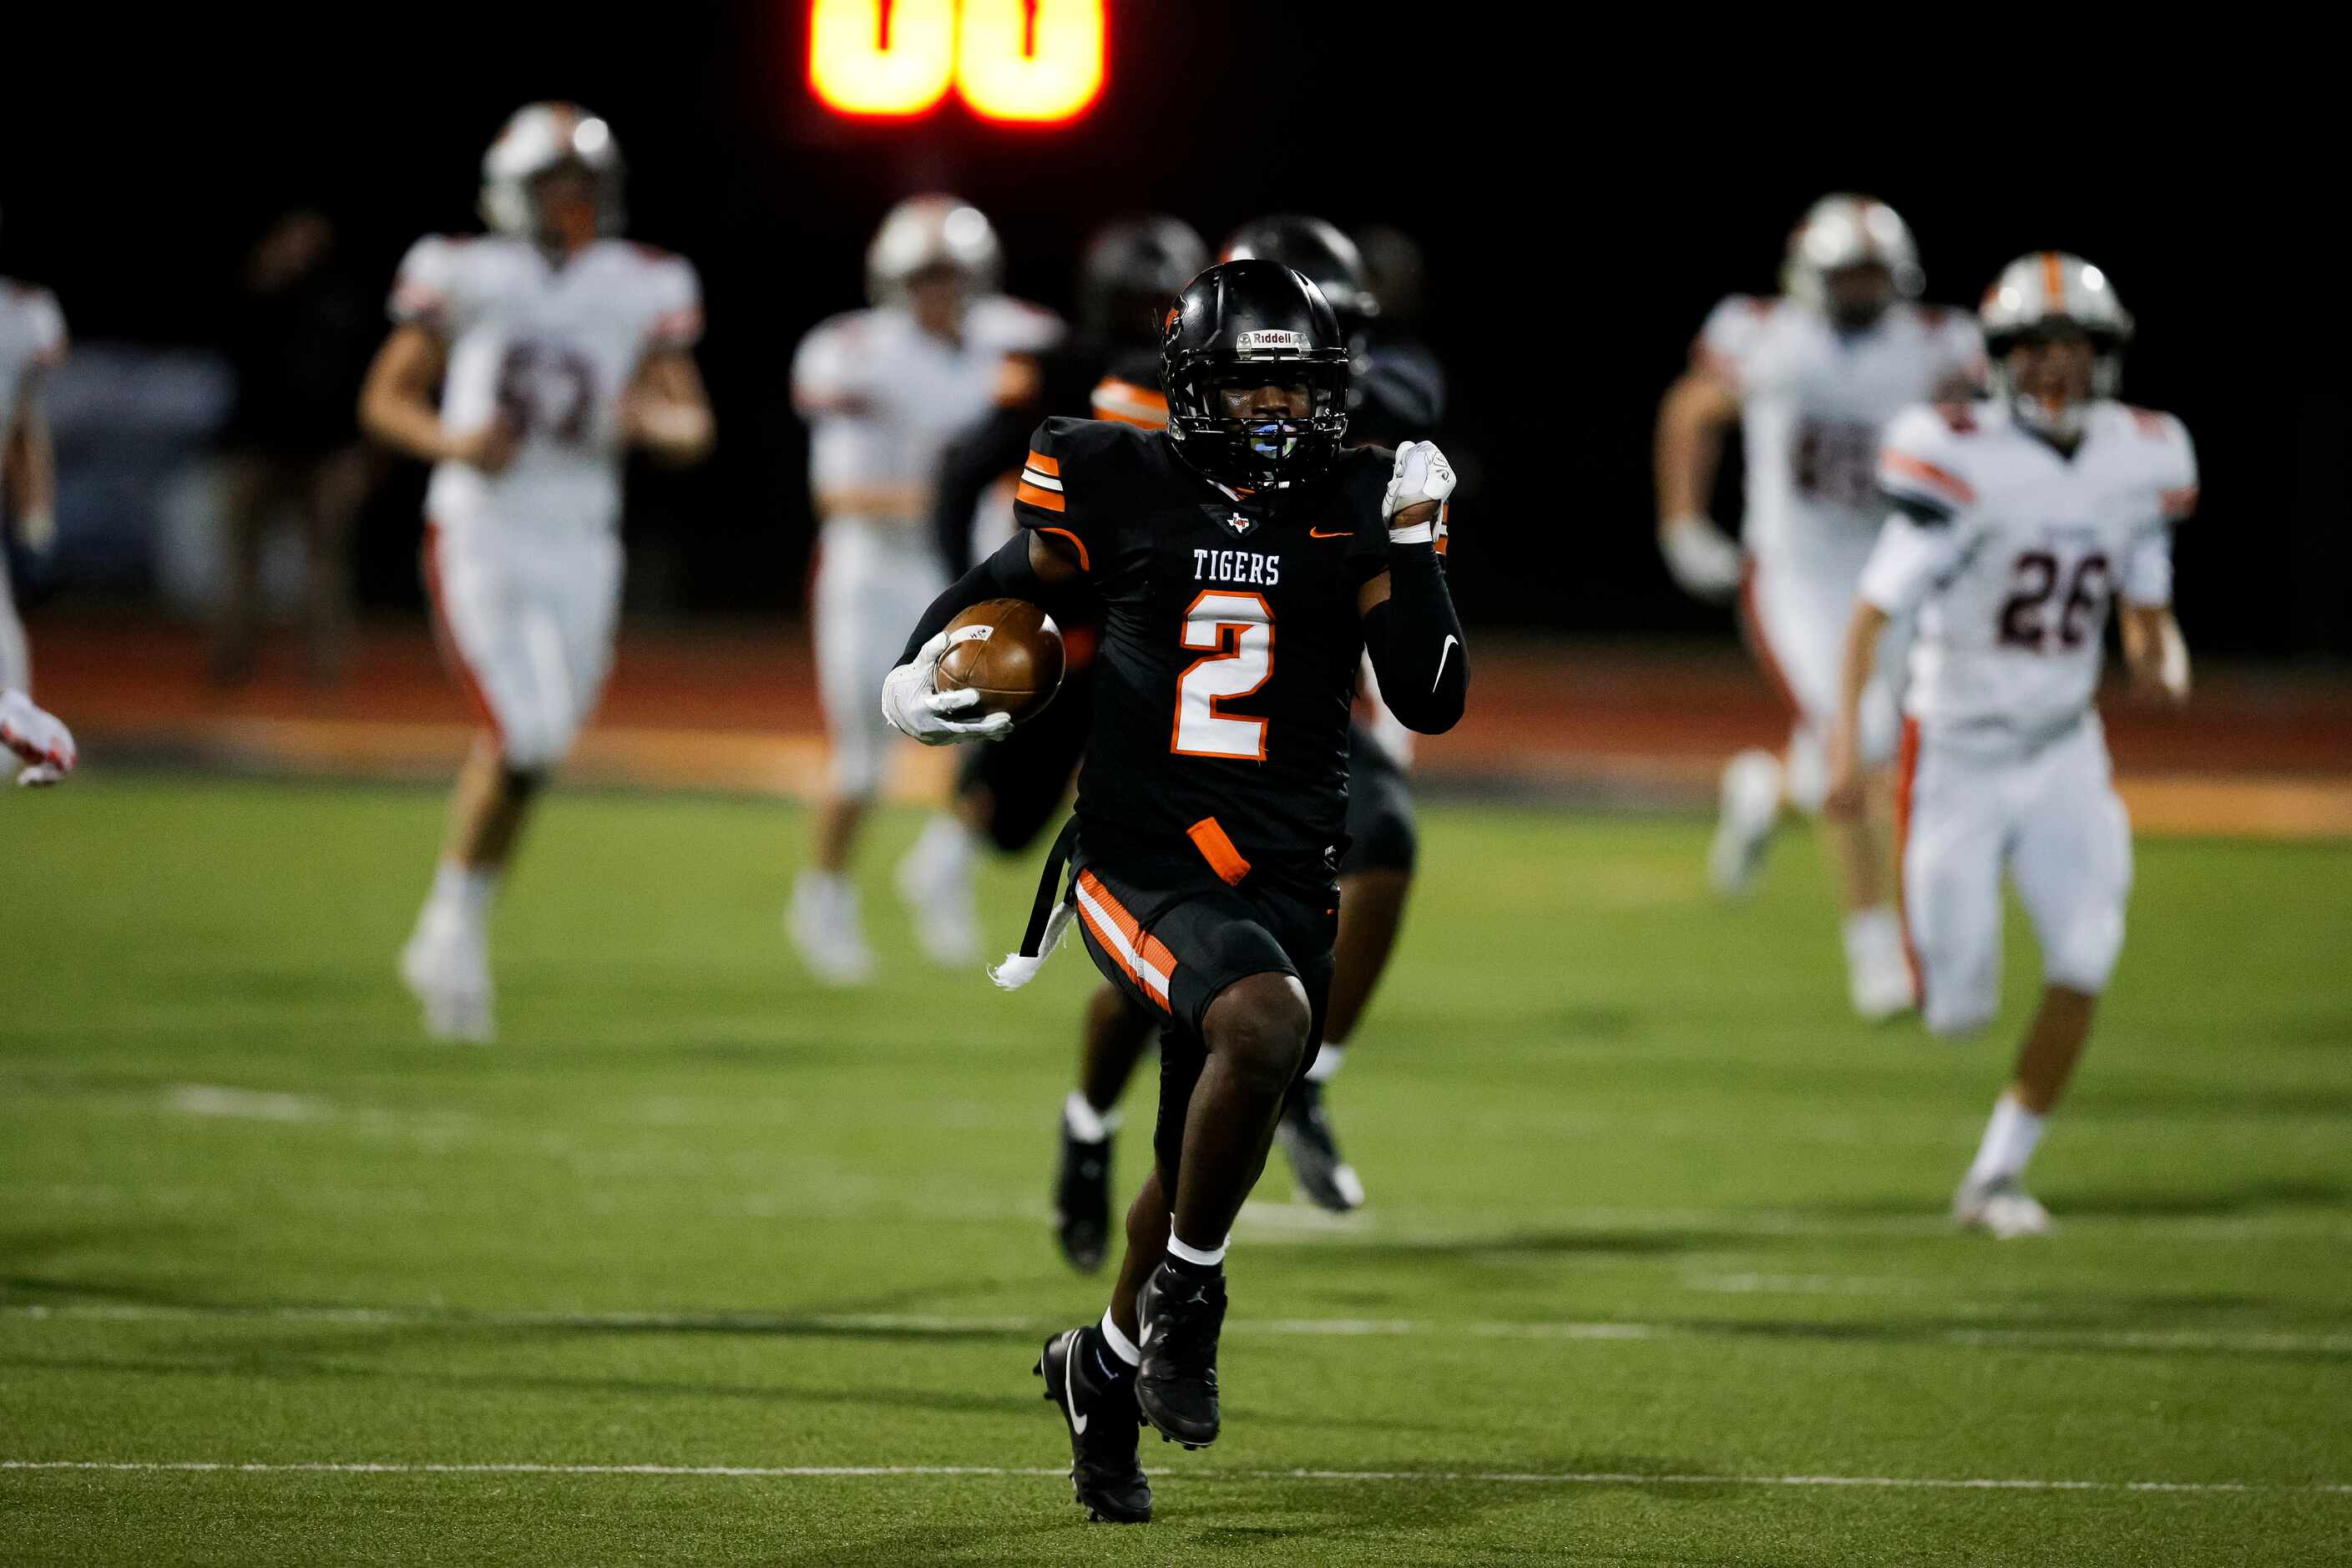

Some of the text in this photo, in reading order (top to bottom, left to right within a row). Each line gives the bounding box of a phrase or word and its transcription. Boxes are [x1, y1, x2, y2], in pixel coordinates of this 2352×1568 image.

[1255, 333, 1291, 343] Riddell
[1193, 549, 1280, 585] TIGERS
[1171, 589, 1276, 761] 2
